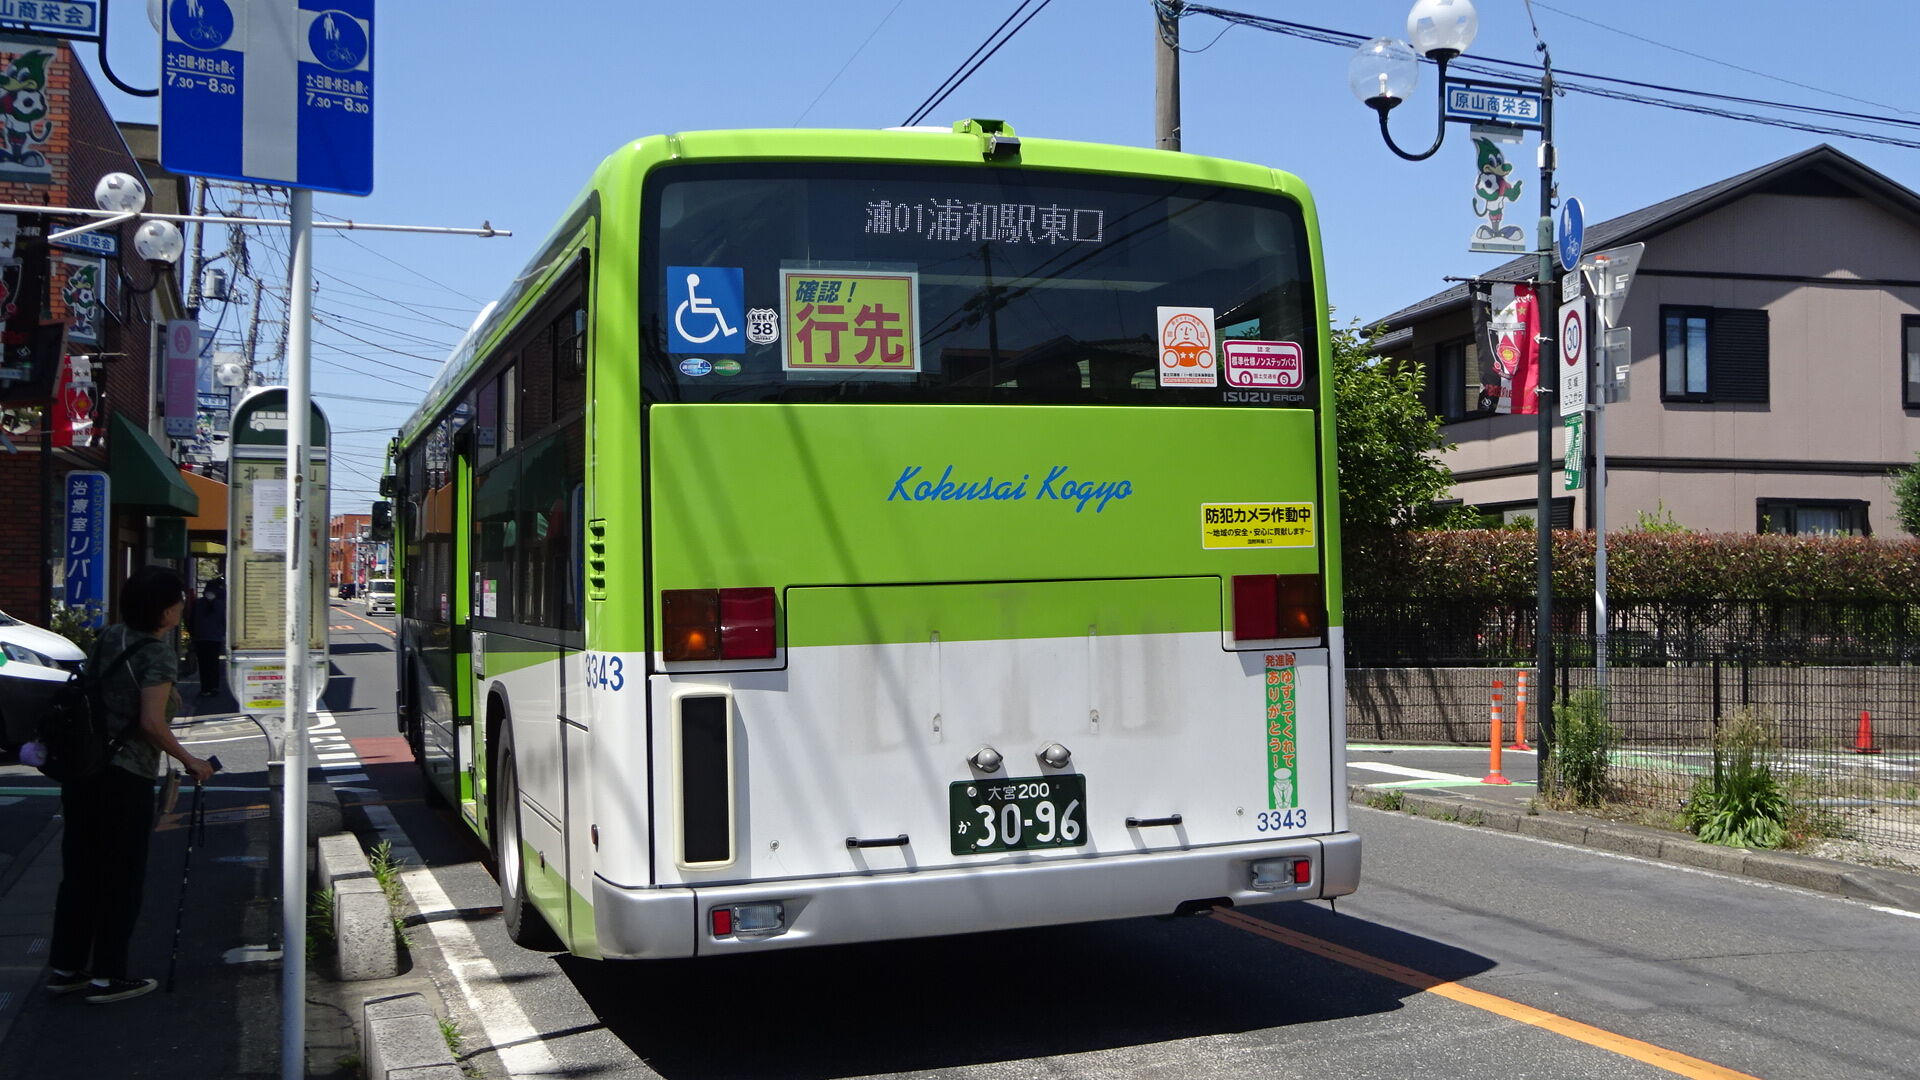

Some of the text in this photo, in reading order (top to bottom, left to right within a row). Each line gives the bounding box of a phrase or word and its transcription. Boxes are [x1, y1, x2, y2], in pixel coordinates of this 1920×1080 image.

[1455, 92, 1532, 116] 原山商栄会
[752, 322, 774, 336] 38
[795, 303, 905, 364] 行先
[1567, 324, 1579, 351] 30
[1223, 391, 1305, 403] ISUZU ERGA
[887, 464, 1133, 514] Kokusai Kogyo
[1205, 507, 1311, 524] 防犯カメラ作動中
[66, 480, 91, 609] 治療室リバー
[585, 654, 625, 691] 3343
[1281, 669, 1296, 768] ゆずってくれて
[988, 782, 1050, 801] 大宮 200
[958, 798, 1081, 847] か 30-96
[1256, 808, 1307, 832] 3343
